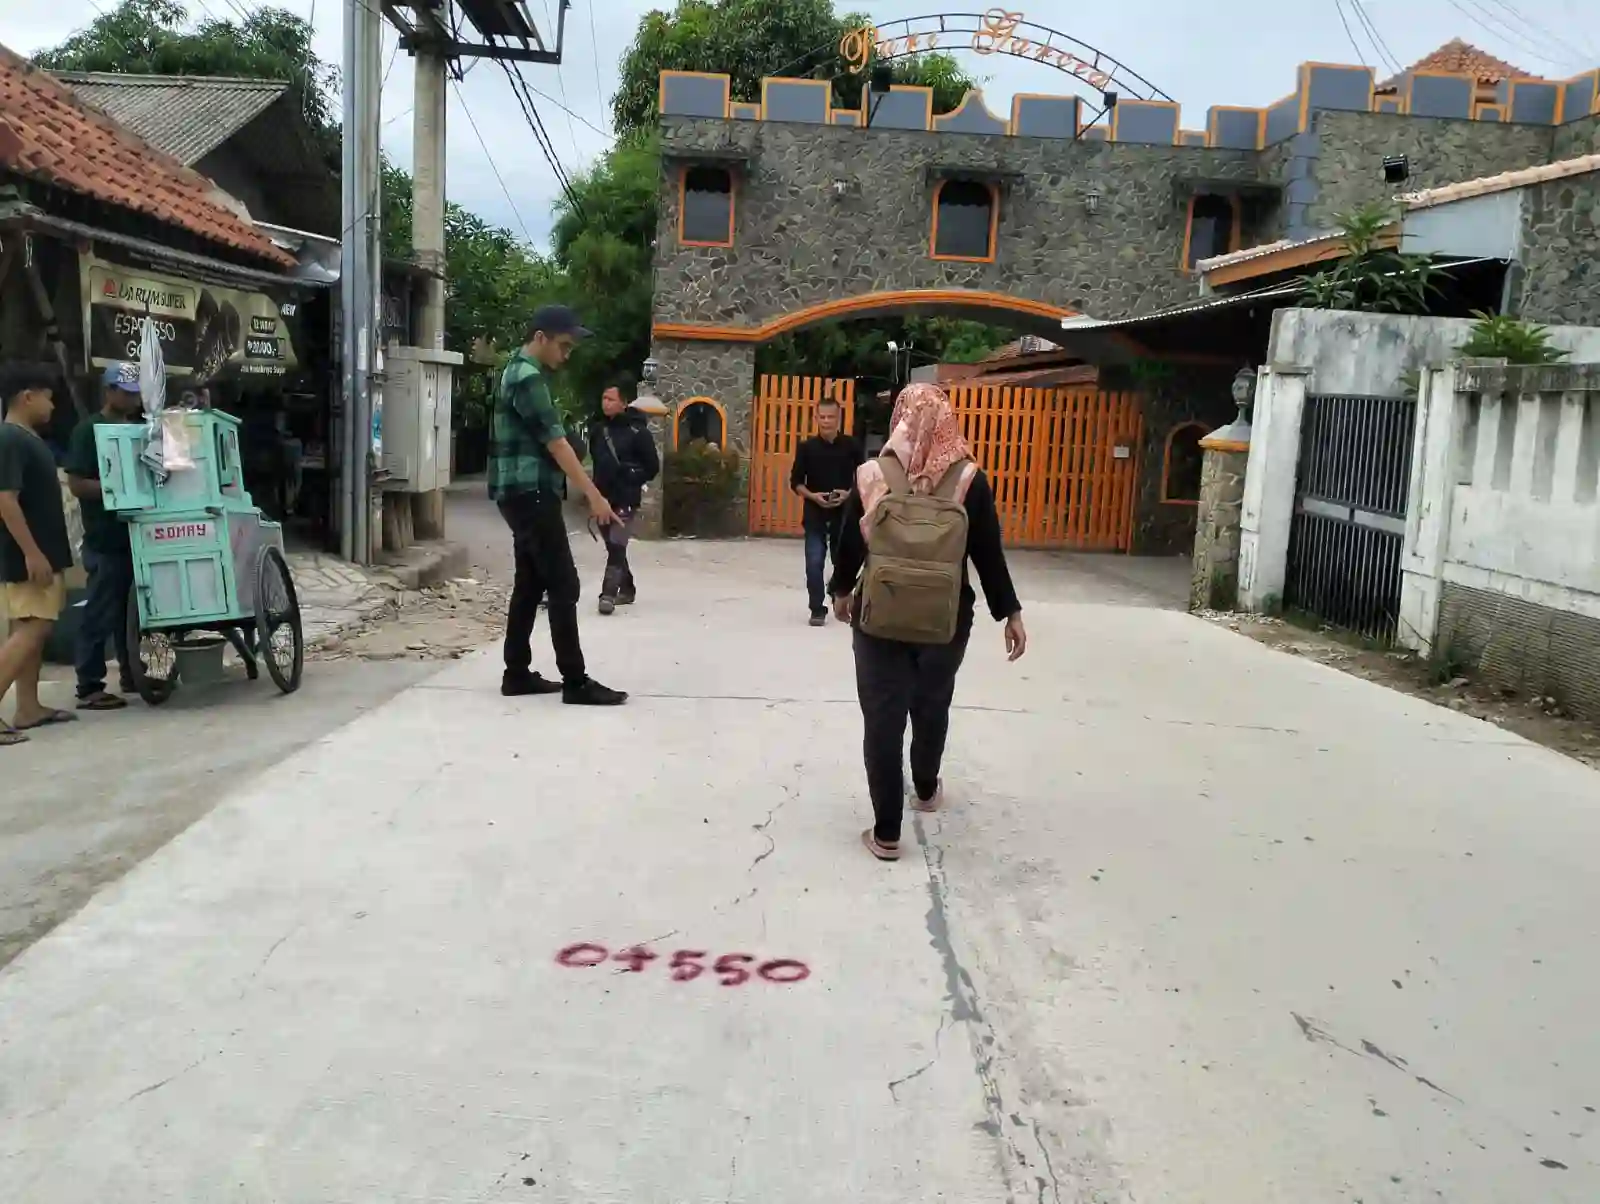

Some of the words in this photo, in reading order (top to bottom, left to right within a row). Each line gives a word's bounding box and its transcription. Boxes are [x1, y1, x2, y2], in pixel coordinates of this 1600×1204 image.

[161, 292, 187, 310] SUPER
[280, 303, 296, 317] NEW
[114, 312, 176, 342] ESPRSSO
[153, 523, 207, 541] SOMAY
